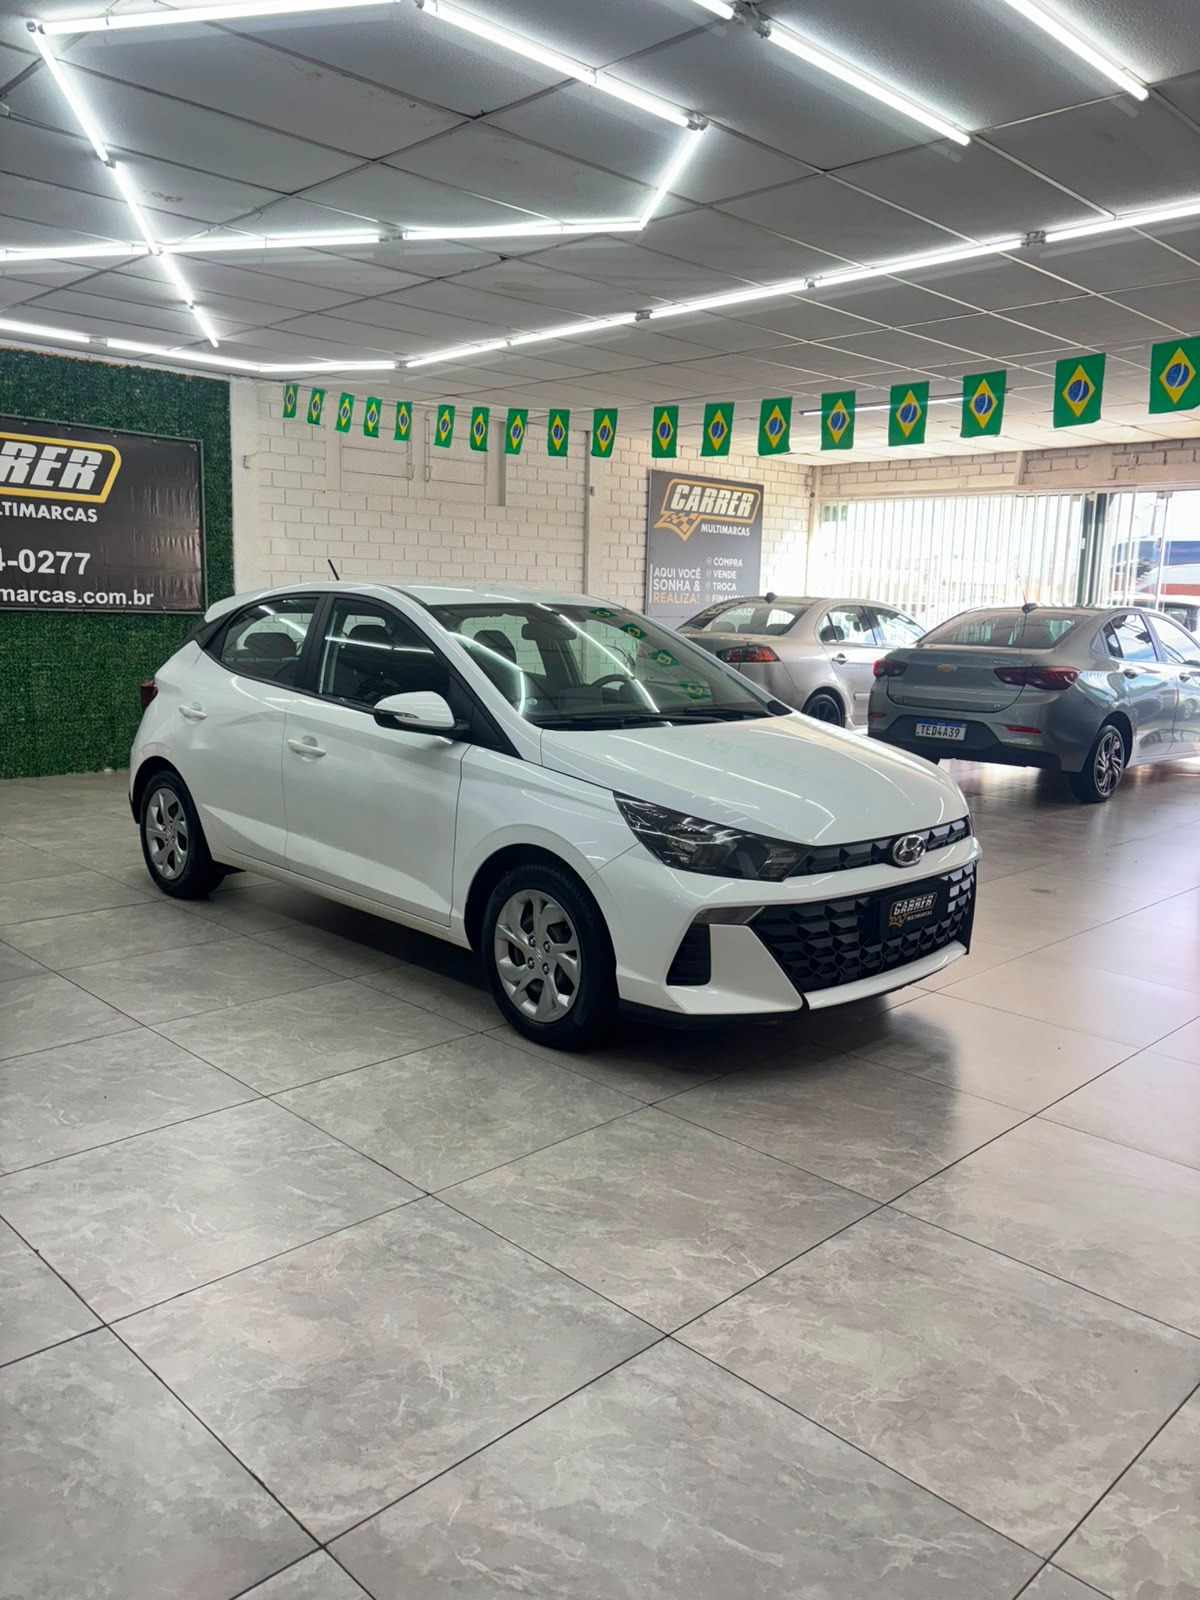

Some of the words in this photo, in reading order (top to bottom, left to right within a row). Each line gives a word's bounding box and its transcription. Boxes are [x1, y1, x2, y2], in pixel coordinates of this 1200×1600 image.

[671, 485, 755, 517] CARRER
[0, 501, 98, 523] TIMARCAS
[701, 524, 750, 536] MULTIMARCAS
[713, 558, 743, 567] COMPRA
[654, 568, 677, 578] AQUI
[679, 568, 701, 579] VOCÊ
[713, 571, 737, 579] VENDE
[653, 579, 691, 591] SONHA
[693, 581, 701, 591] &
[713, 582, 736, 591] TROCA
[653, 592, 700, 604] REALIZA!
[920, 725, 961, 738] TED4A39
[893, 895, 934, 915] CARRER
